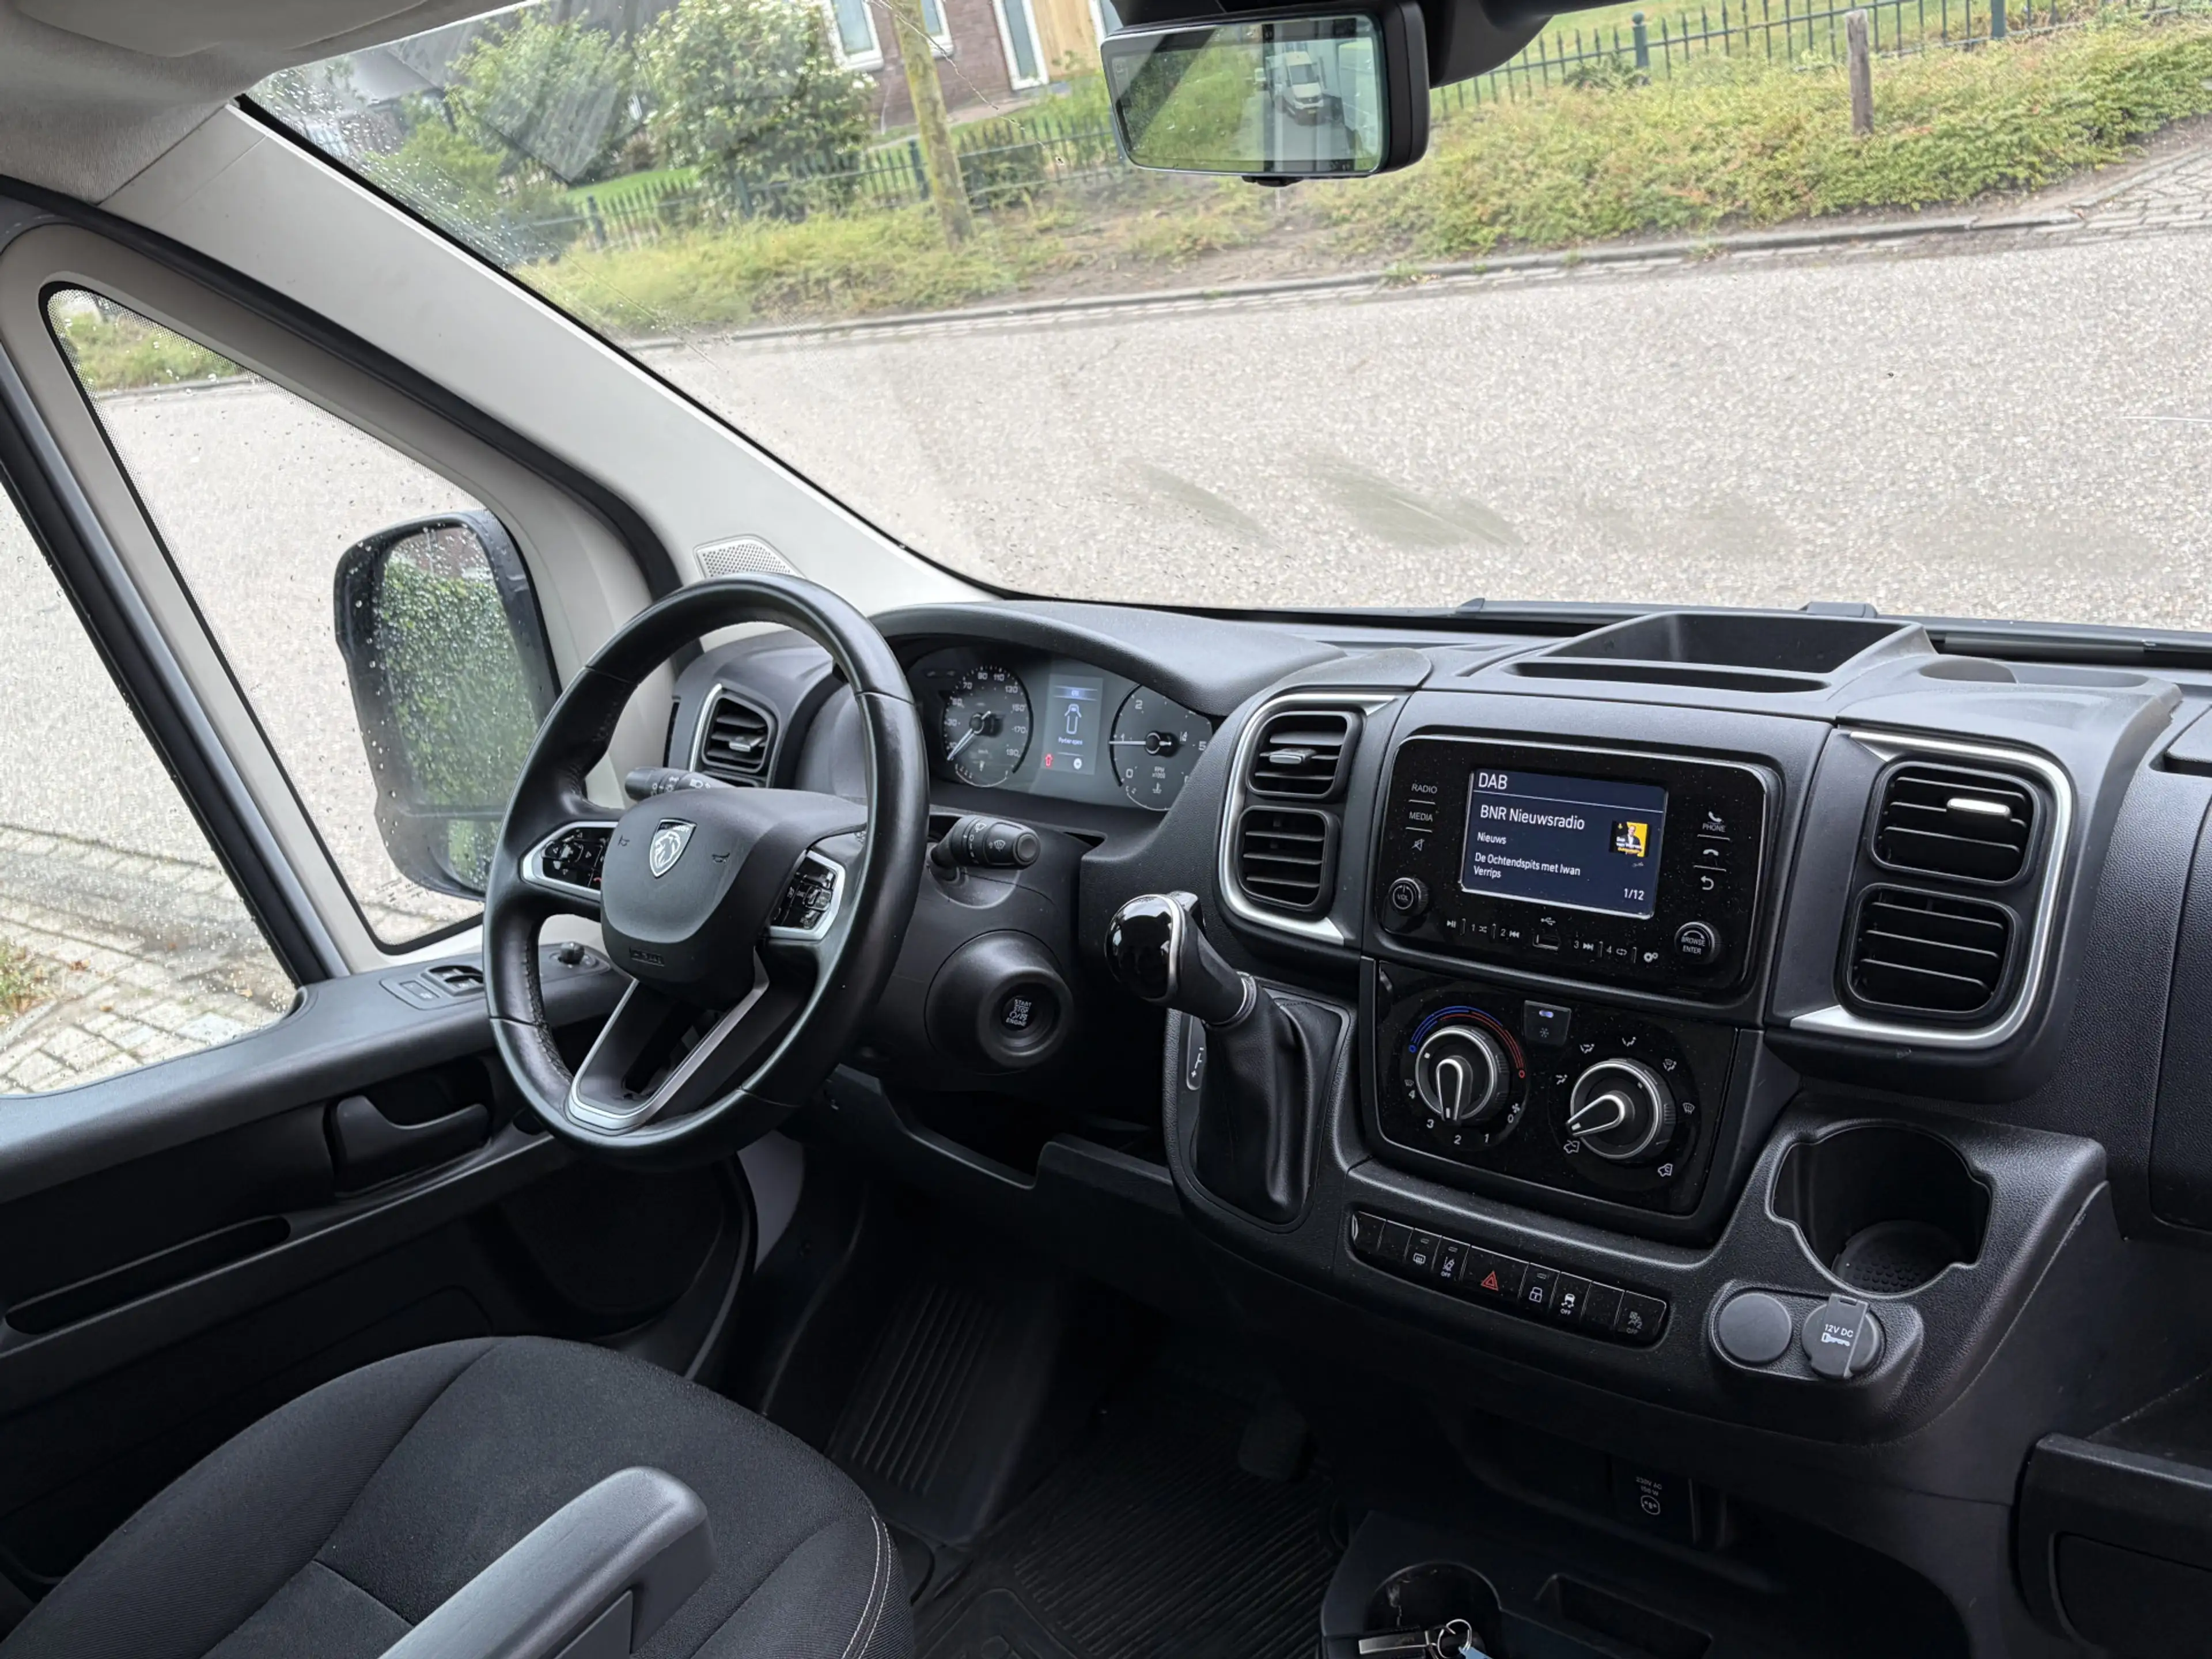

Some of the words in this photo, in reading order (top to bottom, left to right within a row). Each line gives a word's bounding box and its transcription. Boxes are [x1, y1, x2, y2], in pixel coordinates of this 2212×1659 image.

[1012, 703, 1025, 712] 150
[1135, 699, 1143, 710] 2
[1198, 741, 1206, 751] 5
[1478, 772, 1508, 790] DAB
[1411, 783, 1437, 794] RADIO
[1409, 811, 1433, 822] MEDIA
[1480, 804, 1506, 821] BNR
[1509, 808, 1585, 830] Nieuwsradio
[1702, 823, 1726, 832] PHONE
[1477, 832, 1506, 844] Nieuws
[1475, 852, 1486, 863] De
[1487, 854, 1540, 870] Ochtendspits
[1541, 863, 1558, 873] met
[1560, 864, 1581, 876] Iwan
[1474, 865, 1502, 879] Verrips
[1624, 888, 1645, 900] 1/12
[1472, 923, 1475, 931] 1
[1501, 929, 1506, 937] 2
[1574, 941, 1579, 949] 3
[1681, 936, 1706, 947] BROWSE
[1606, 945, 1612, 953] 4
[1683, 945, 1701, 955] ENTER
[1014, 999, 1032, 1007] START
[1409, 1090, 1415, 1099] 4
[1426, 1119, 1434, 1128] 3
[1508, 1114, 1514, 1123] 0
[1454, 1135, 1461, 1145] 2
[1484, 1134, 1490, 1143] 1
[1825, 1324, 1840, 1334] 12V
[1840, 1328, 1853, 1338] DC
